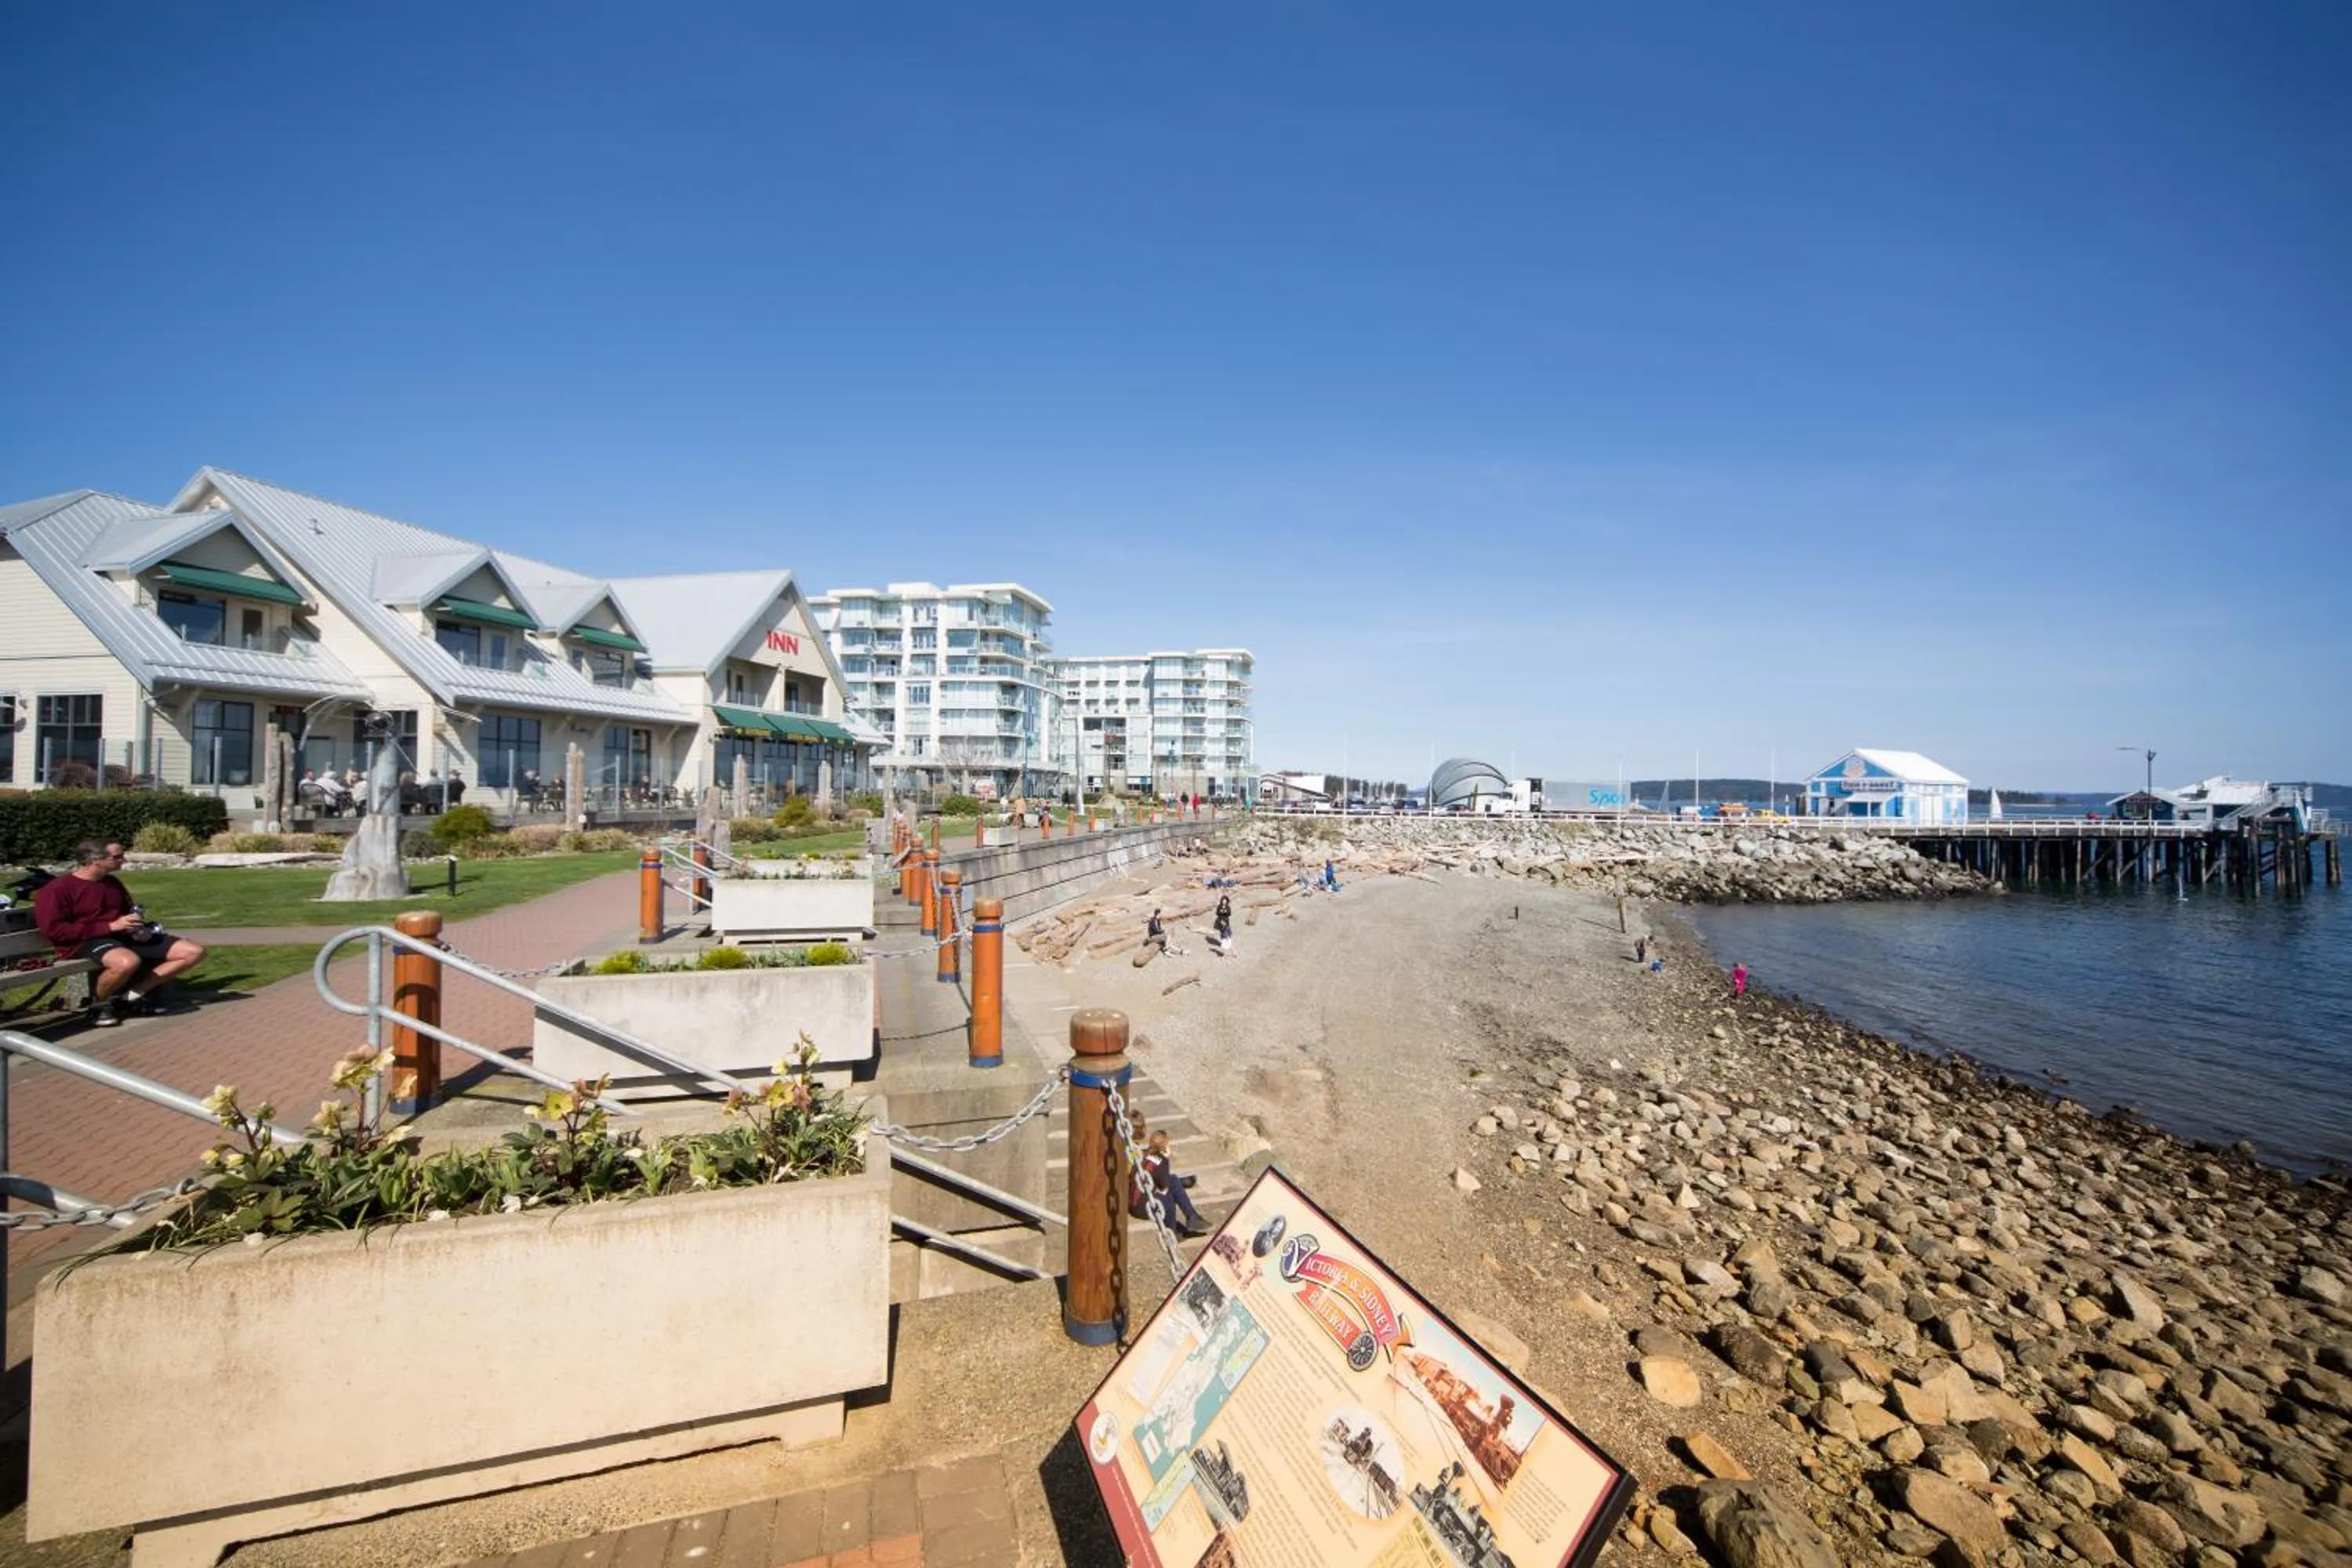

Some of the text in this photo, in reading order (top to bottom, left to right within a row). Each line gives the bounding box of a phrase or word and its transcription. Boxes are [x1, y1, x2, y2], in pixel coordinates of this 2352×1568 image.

[766, 630, 799, 655] INN
[1282, 1237, 1348, 1284] VICTORIA
[1349, 1279, 1363, 1292] &
[1359, 1287, 1394, 1338] SIDNEY
[1308, 1290, 1355, 1339] RAILWAY
